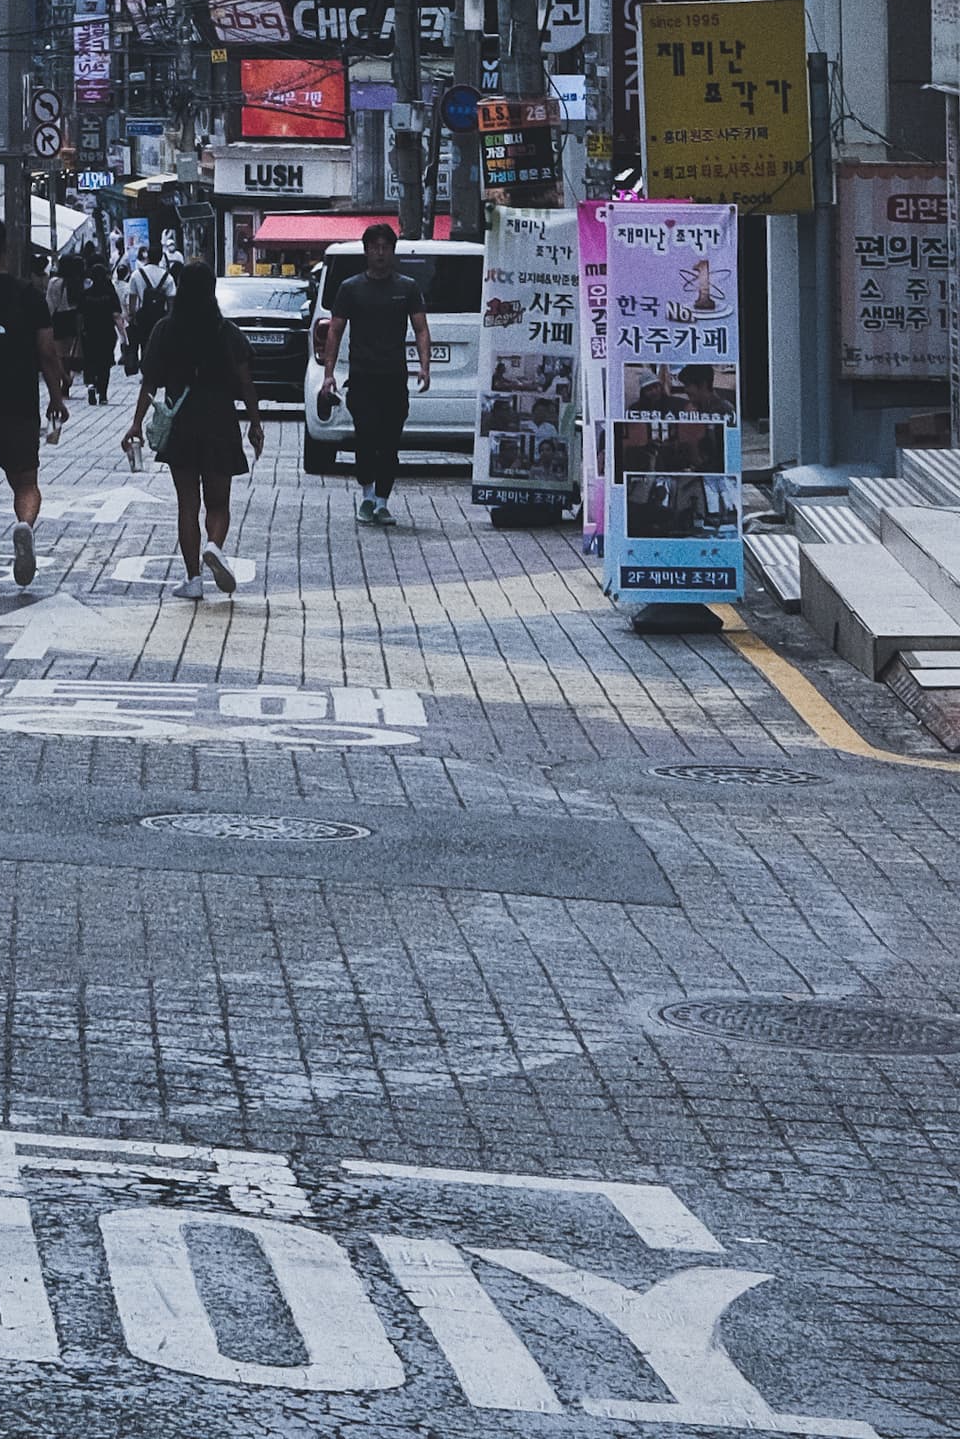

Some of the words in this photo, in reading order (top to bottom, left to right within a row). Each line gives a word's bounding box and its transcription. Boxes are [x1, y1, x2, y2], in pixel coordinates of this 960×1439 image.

[649, 15, 681, 28] since
[686, 14, 720, 27] 1995
[656, 40, 746, 77] 재미난
[704, 79, 792, 115] 조각가
[244, 163, 304, 187] LUSH
[618, 228, 666, 252] 재미난
[676, 228, 720, 252] 조각가
[529, 292, 575, 317] 사주
[616, 295, 660, 317] 한국
[859, 305, 930, 330] 생맥주
[528, 322, 574, 345] 카페
[617, 326, 728, 354] 사주카페
[627, 572, 645, 584] 2F
[649, 572, 688, 586] 재미난
